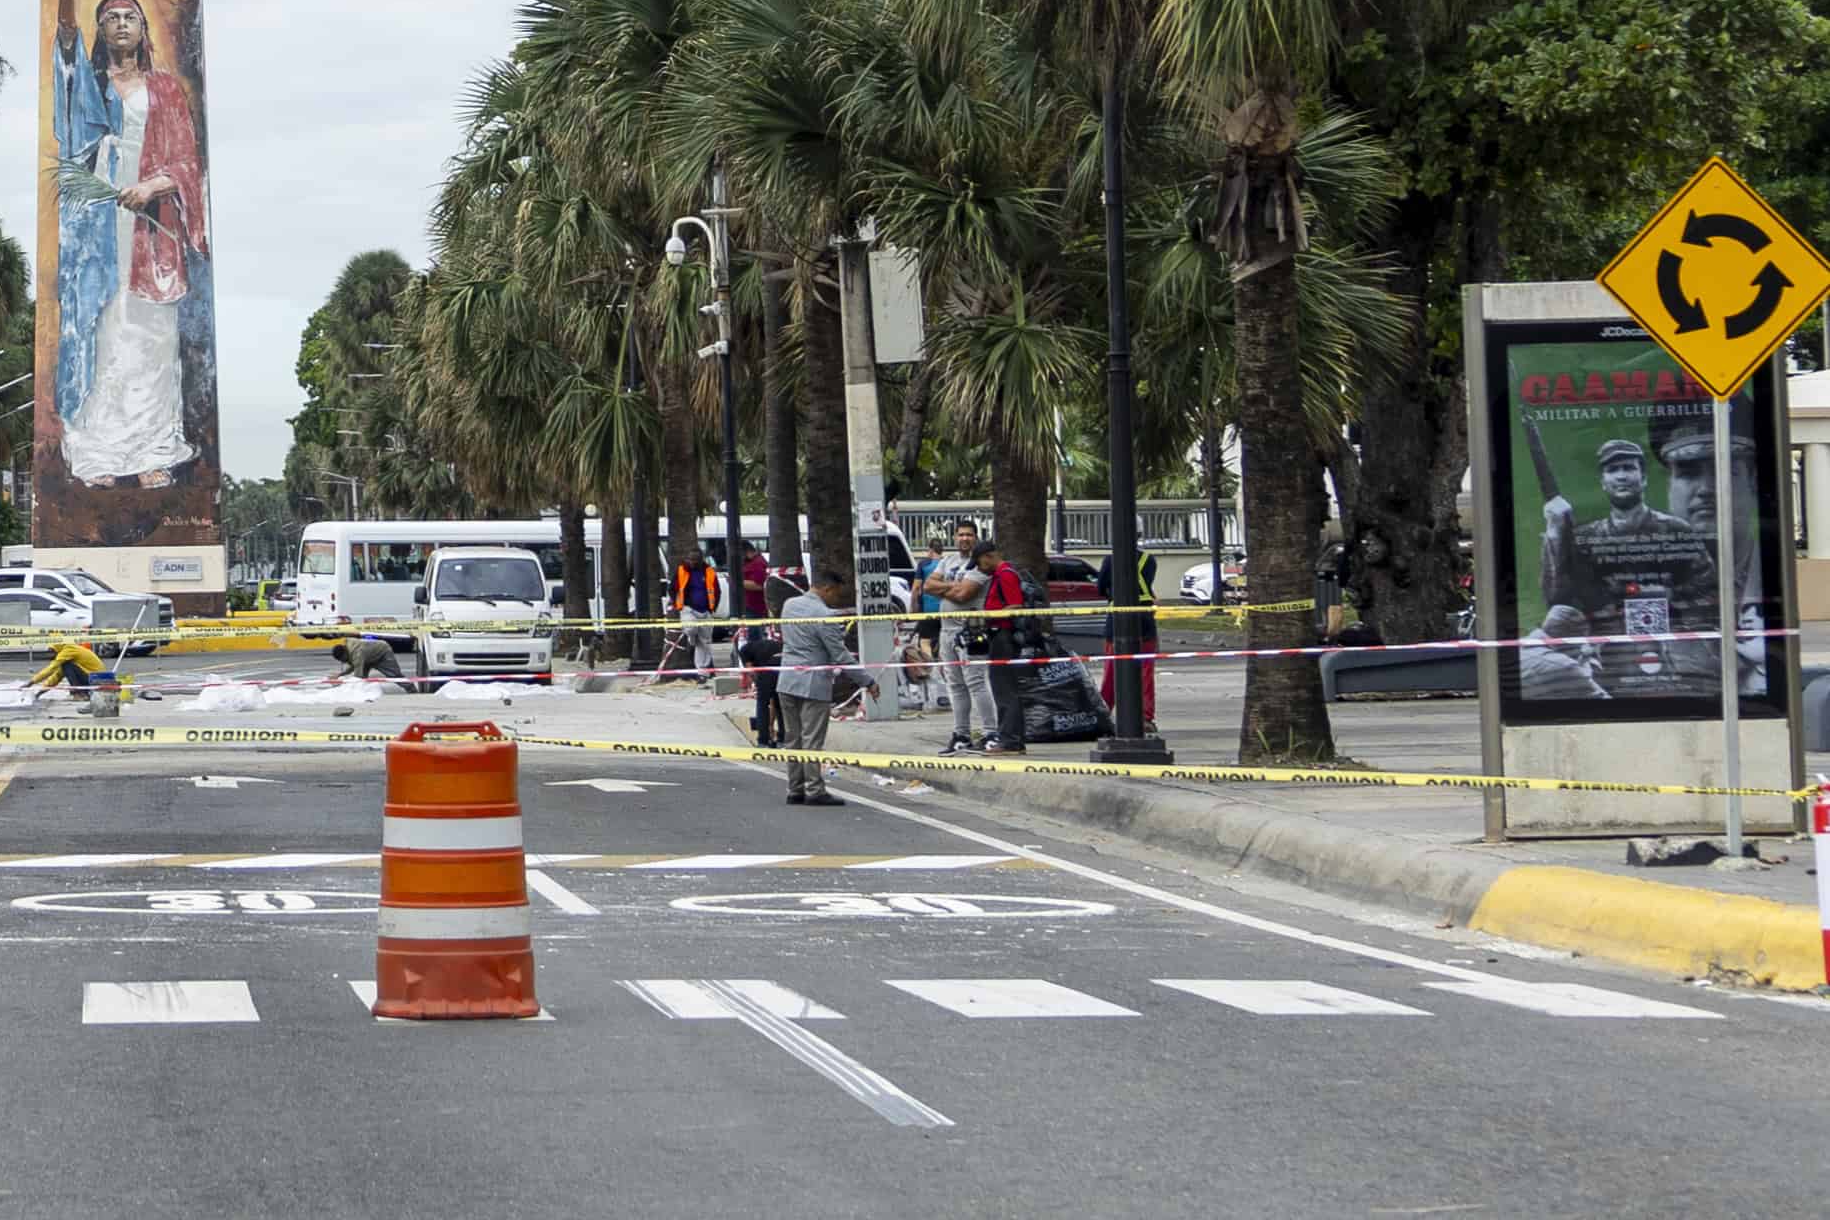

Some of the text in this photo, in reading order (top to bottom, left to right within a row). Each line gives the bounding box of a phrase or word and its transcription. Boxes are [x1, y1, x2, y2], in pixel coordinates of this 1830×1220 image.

[1600, 326, 1648, 338] JCDeca
[1521, 369, 1718, 406] CAAMA
[1534, 407, 1601, 422] MILITAR
[1608, 407, 1617, 419] A
[1624, 403, 1734, 418] GUERRILLEO
[163, 563, 185, 573] ADN
[860, 557, 888, 574] DURO
[870, 581, 888, 599] 829
[146, 893, 317, 911] 30
[801, 894, 985, 915] 30
